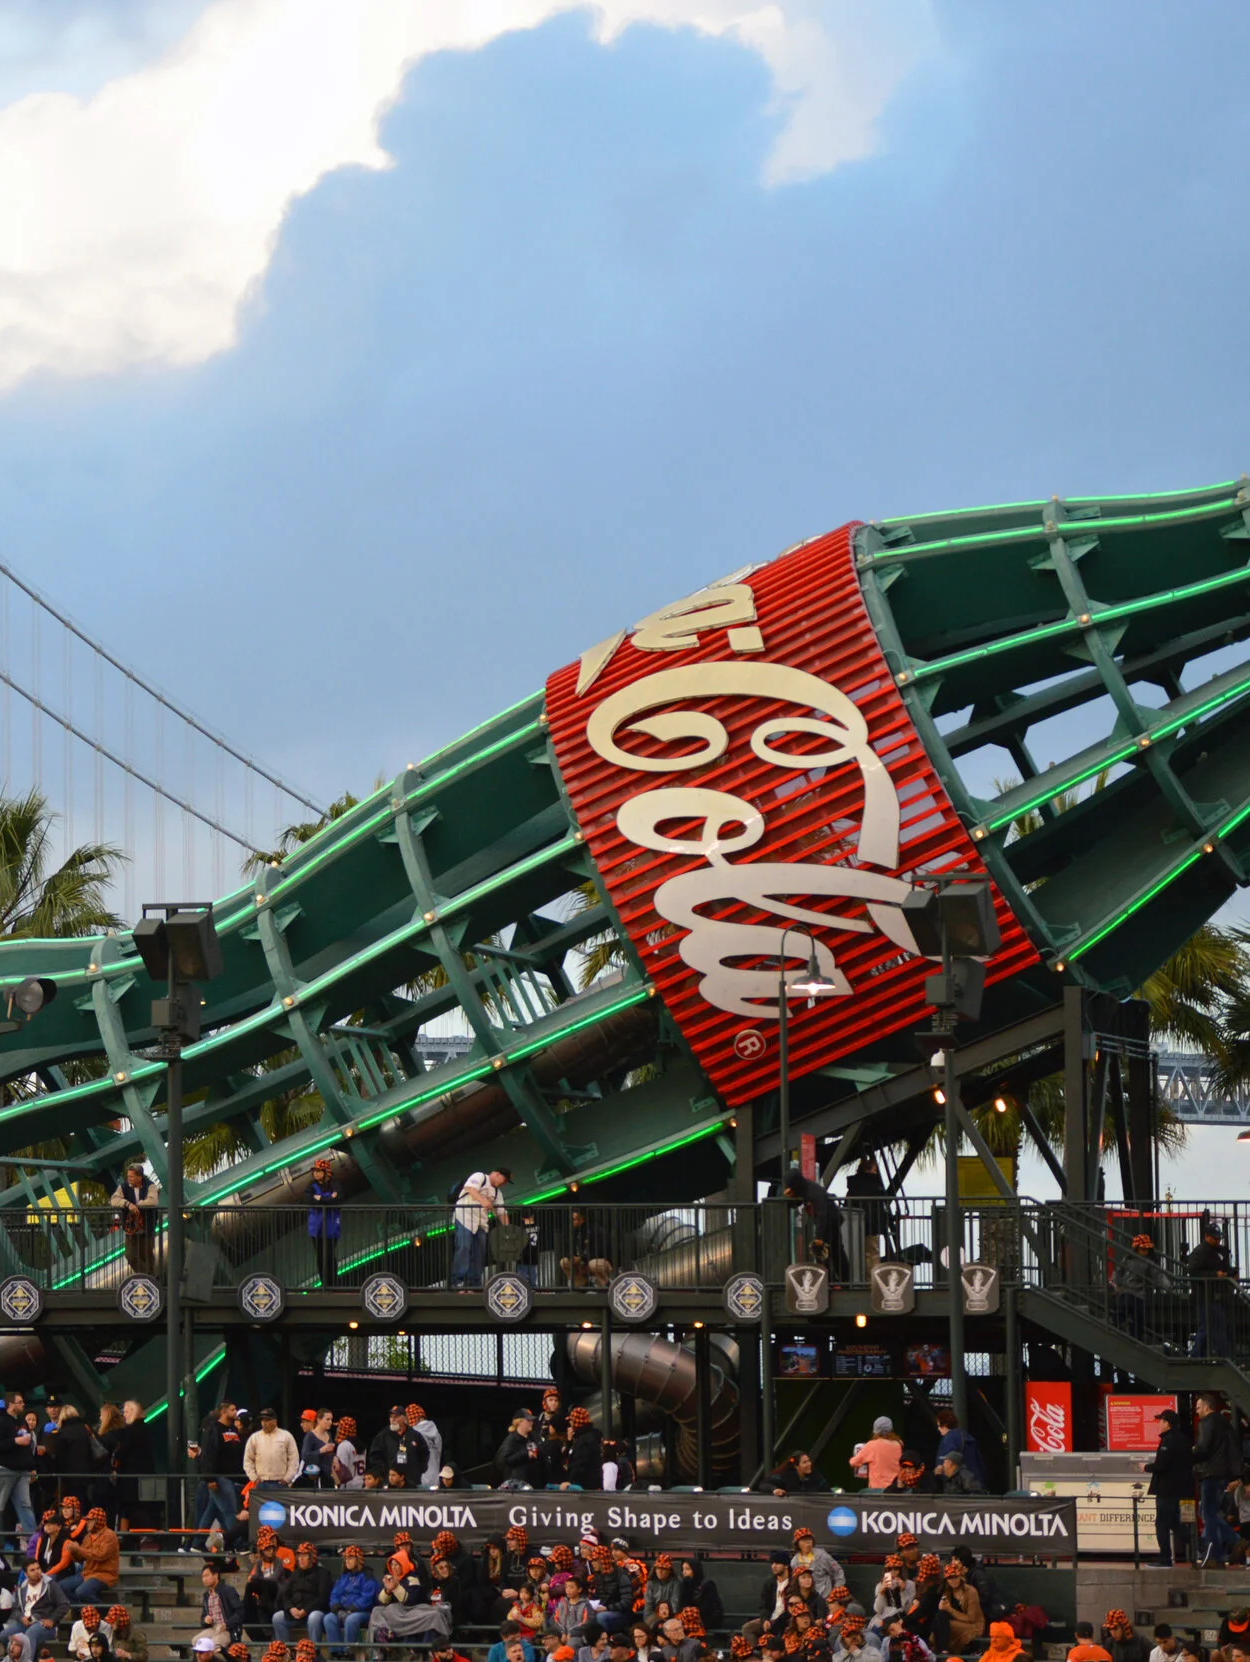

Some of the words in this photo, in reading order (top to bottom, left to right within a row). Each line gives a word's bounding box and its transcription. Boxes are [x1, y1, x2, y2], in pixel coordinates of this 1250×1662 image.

[290, 1505, 376, 1527] KONICA
[379, 1505, 477, 1528] MINOLTA
[509, 1506, 594, 1534] Giving
[608, 1506, 681, 1535] Shape
[693, 1510, 718, 1529] to
[729, 1508, 792, 1530] Ideas
[861, 1511, 956, 1535] KONICA
[960, 1512, 1068, 1537] MINOLTA
